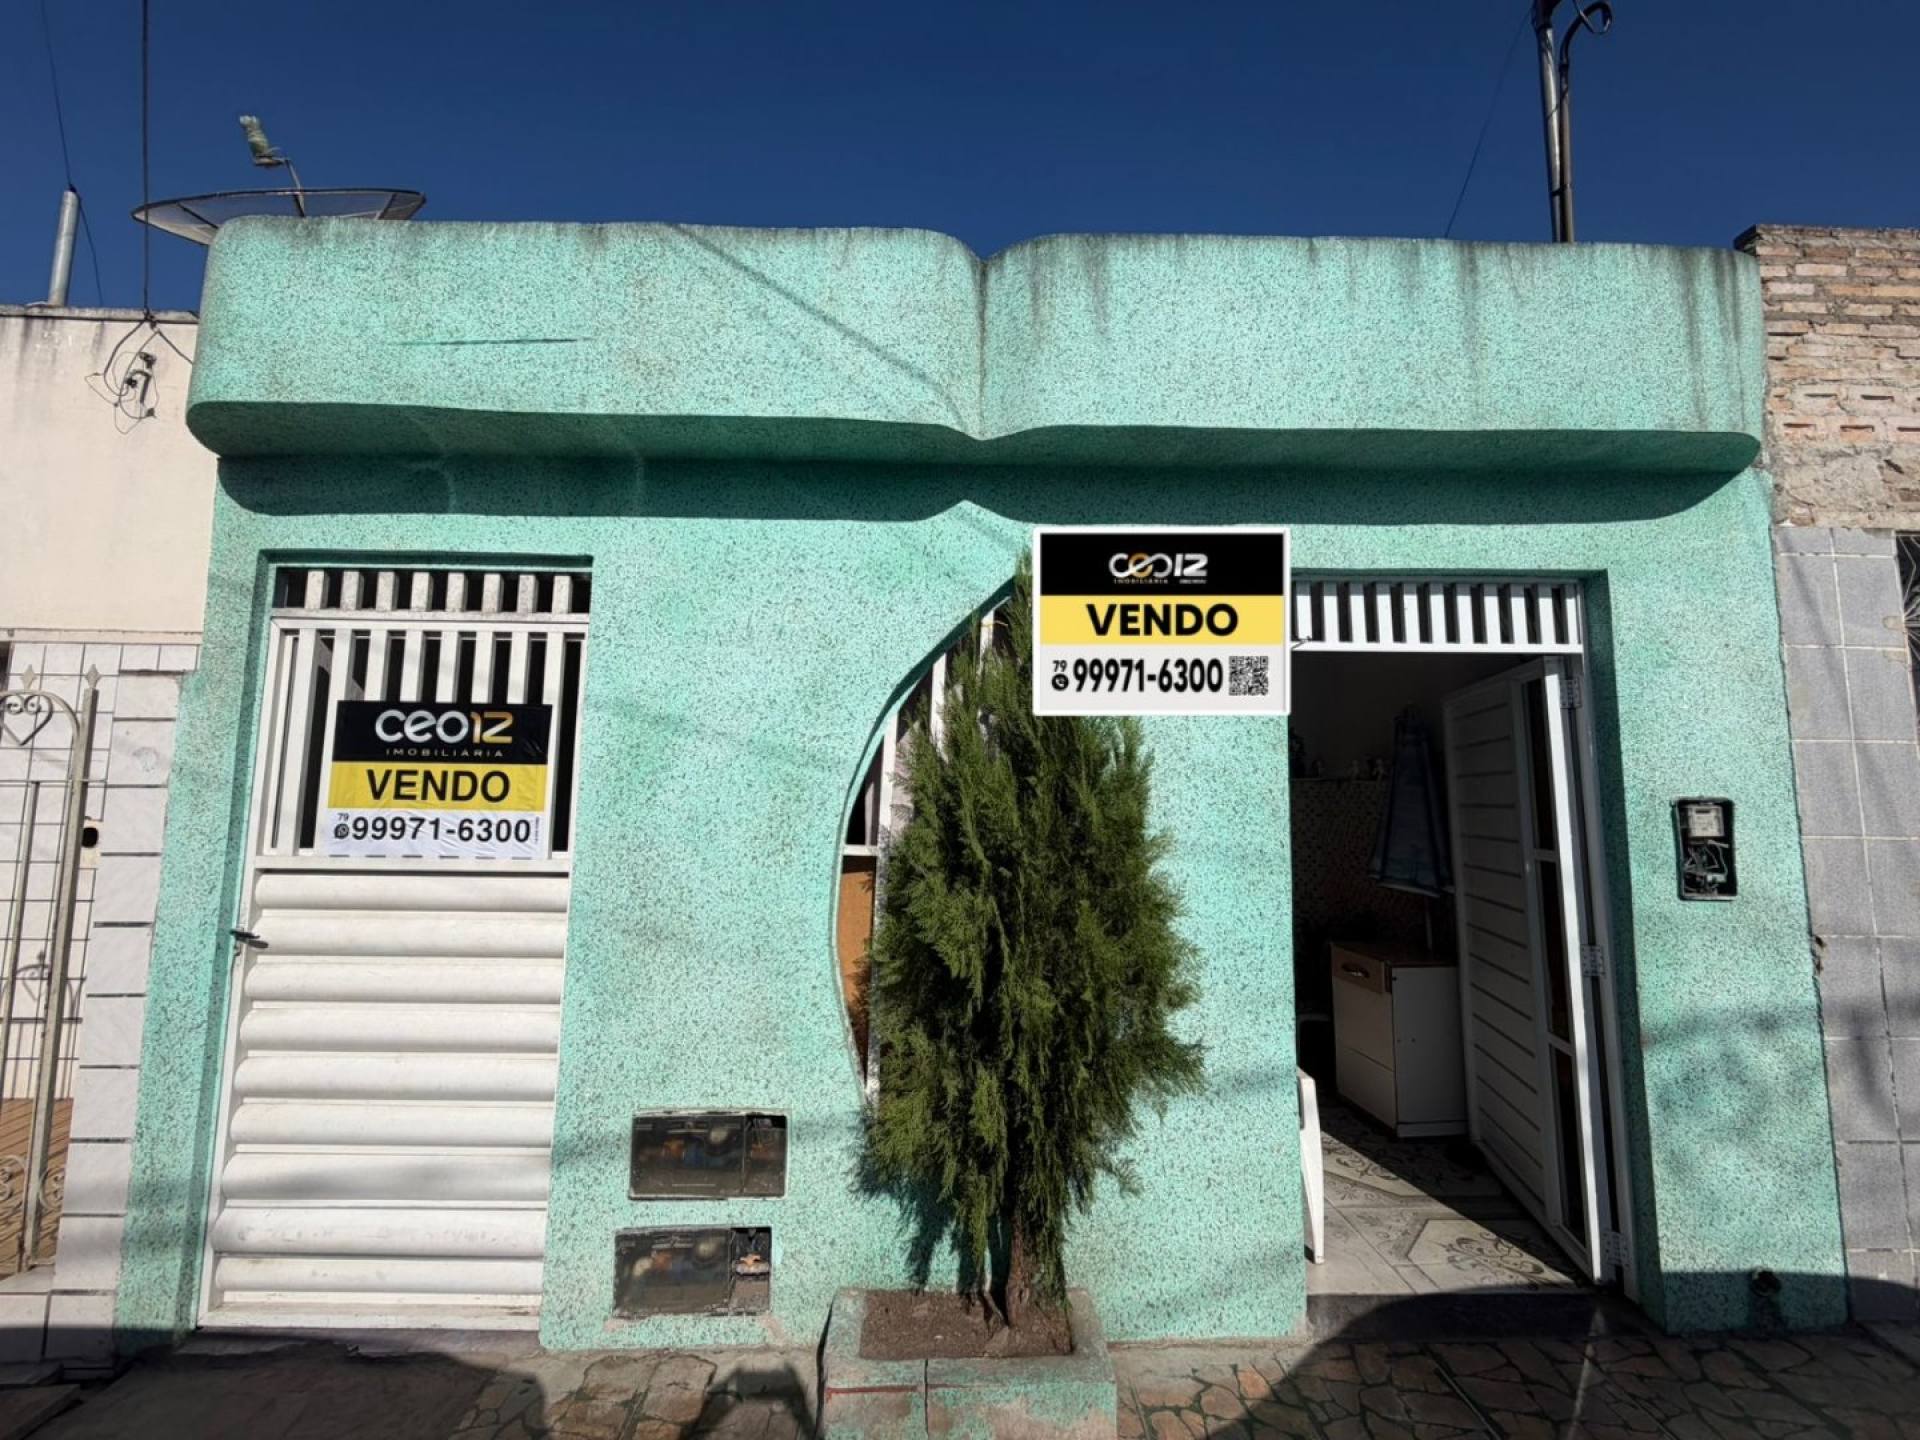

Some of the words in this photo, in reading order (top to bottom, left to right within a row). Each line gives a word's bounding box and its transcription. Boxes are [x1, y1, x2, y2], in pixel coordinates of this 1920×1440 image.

[1086, 603, 1238, 636] VENDO
[1053, 661, 1068, 672] 79
[1073, 658, 1223, 692] 99971-6300
[366, 768, 510, 802] VENDO
[337, 813, 350, 821] 79
[352, 816, 530, 842] 99971-6300
